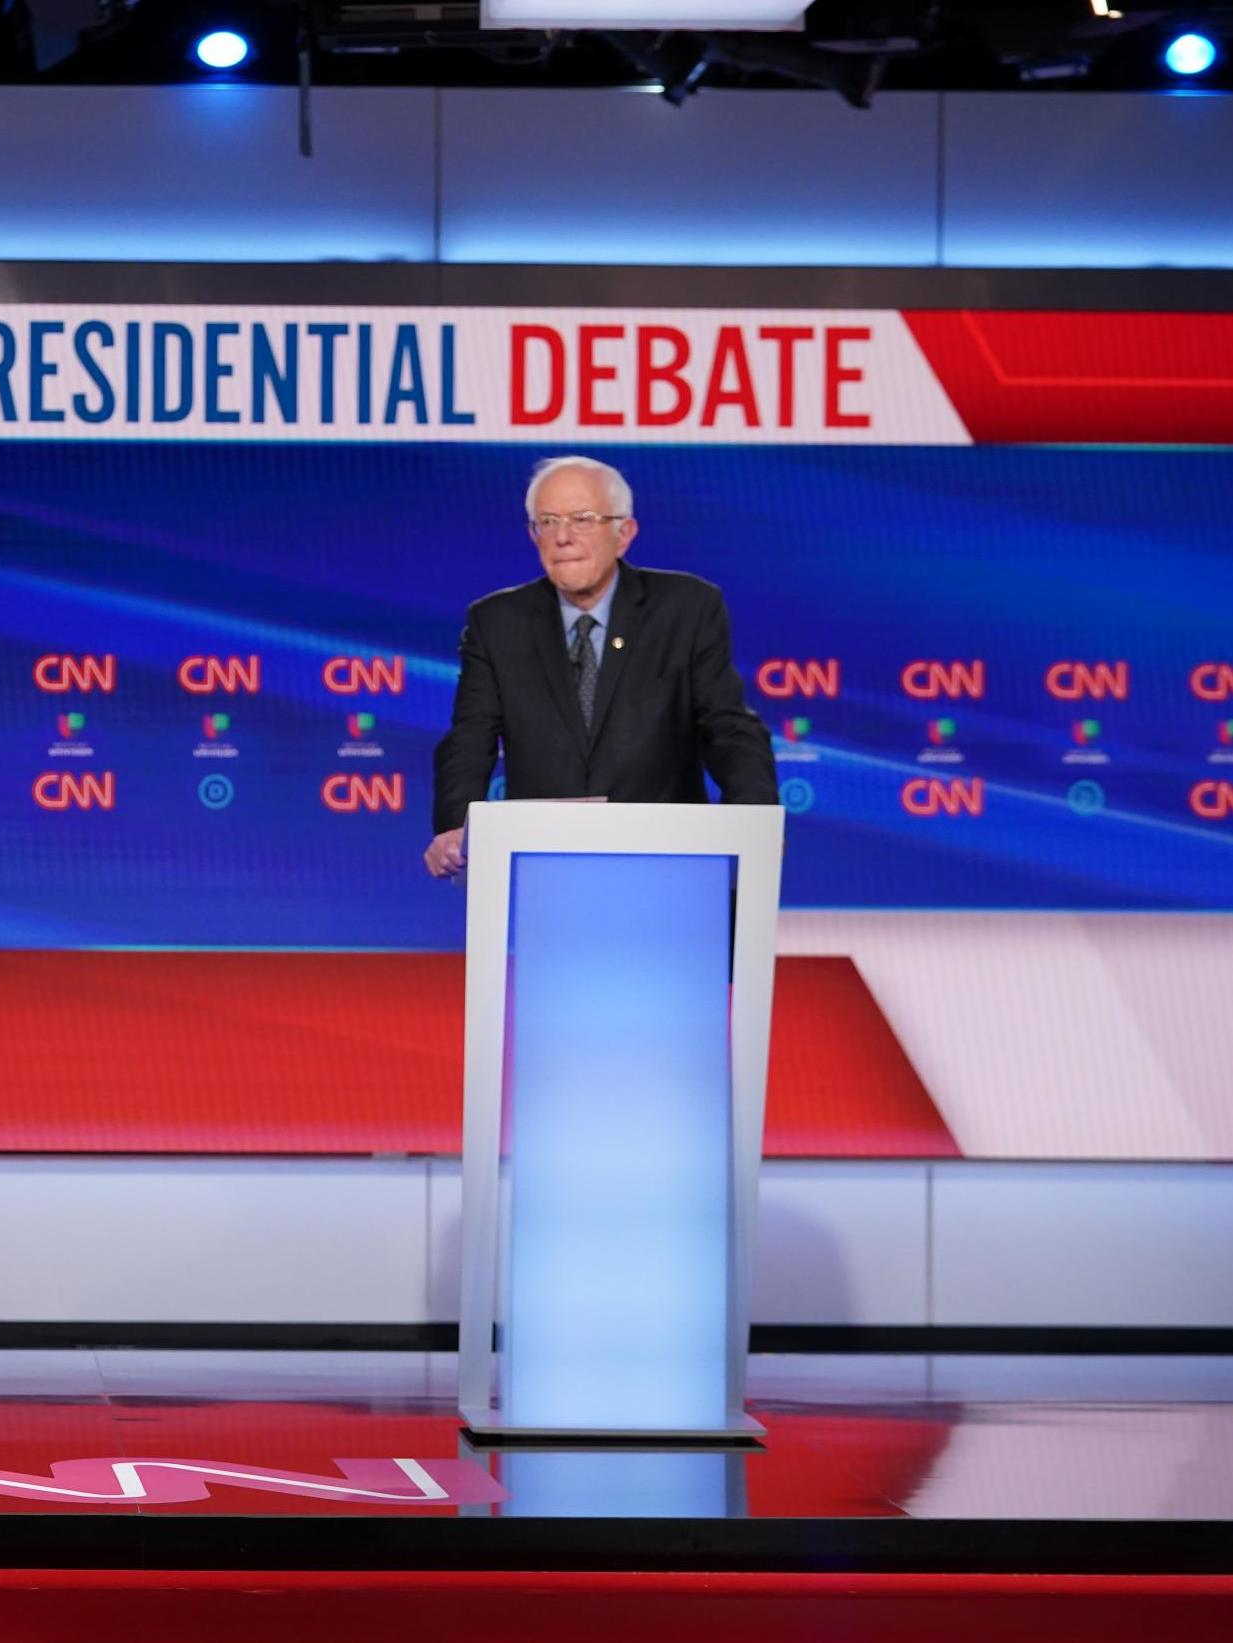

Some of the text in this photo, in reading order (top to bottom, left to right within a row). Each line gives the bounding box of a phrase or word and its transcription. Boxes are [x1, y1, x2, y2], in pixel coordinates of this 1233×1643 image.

[509, 323, 874, 429] DEBATE
[34, 655, 114, 691] CNN
[179, 656, 259, 692] CNN
[323, 657, 403, 693] CNN
[757, 660, 838, 697] CNN
[902, 661, 983, 698] CNN
[1046, 662, 1127, 699] CNN
[33, 772, 114, 809] CNN
[322, 774, 402, 811] CNN
[902, 779, 982, 815] CNN
